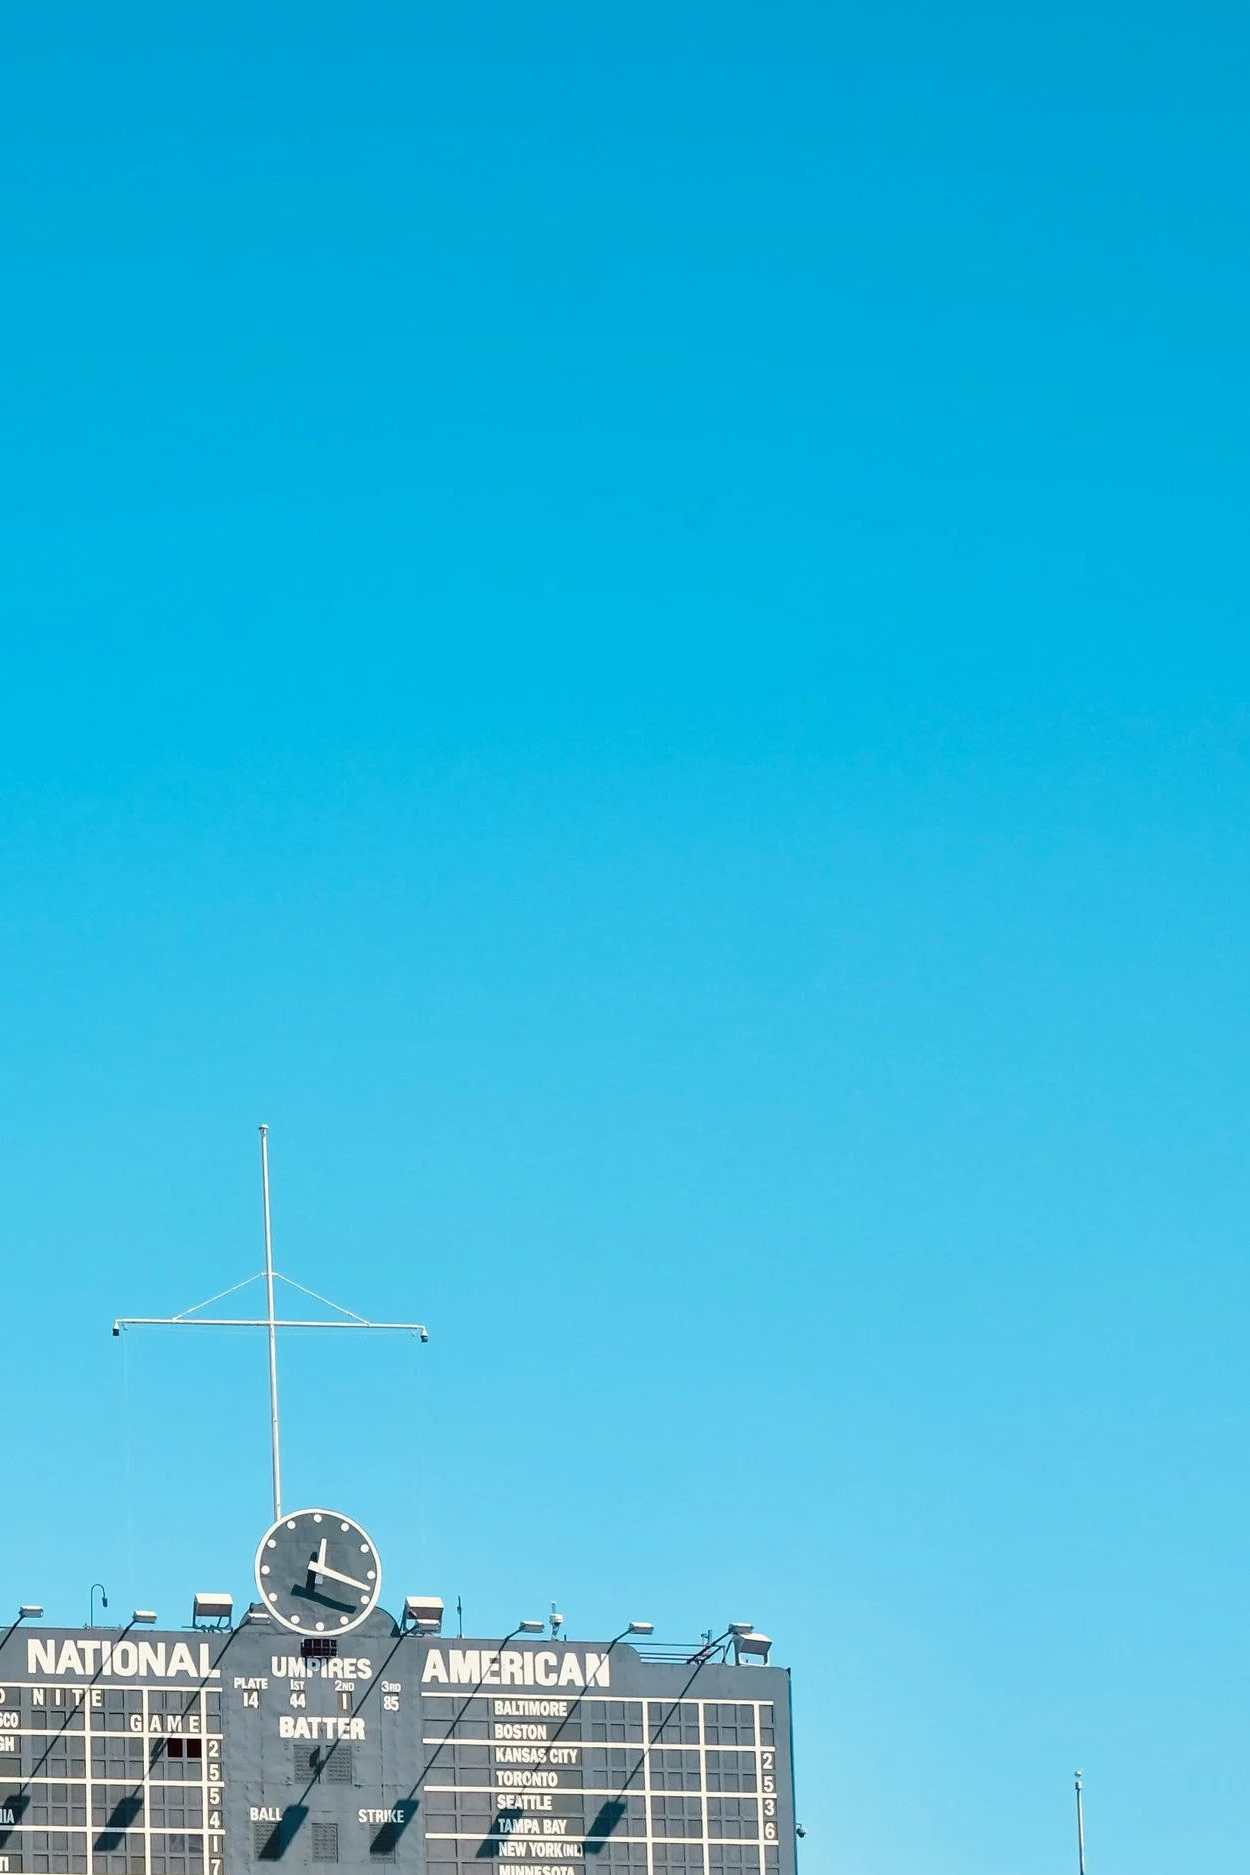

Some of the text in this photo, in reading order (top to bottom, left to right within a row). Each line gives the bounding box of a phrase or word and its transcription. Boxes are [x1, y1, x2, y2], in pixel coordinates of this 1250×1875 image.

[28, 1639, 220, 1678] NATIONAL
[272, 1656, 372, 1679] UMPIRES
[422, 1649, 609, 1687] AMERICAN
[234, 1678, 401, 1692] PLATE 1ST 2ND 3RD
[244, 1692, 398, 1710] 14 44 1 85
[495, 1701, 567, 1716] BALTIMORE
[280, 1717, 365, 1739] BATTER
[495, 1724, 546, 1739] BOSTON
[209, 1741, 218, 1757] 2
[496, 1748, 577, 1763] KANSAS CITY
[763, 1753, 772, 1769] 2
[210, 1764, 219, 1780] 5
[497, 1771, 557, 1787] TORONTO
[764, 1776, 773, 1792] 5
[210, 1788, 219, 1804] 5
[497, 1795, 552, 1810] SEATTLE
[250, 1808, 281, 1820] BALL
[765, 1800, 774, 1815] 3
[210, 1812, 220, 1828] 4
[358, 1809, 403, 1823] STRIKE
[499, 1819, 566, 1834] TAMPA BAY
[765, 1823, 775, 1839] 6
[214, 1836, 217, 1852] 1
[500, 1842, 526, 1856] NEW
[211, 1860, 220, 1875] 7
